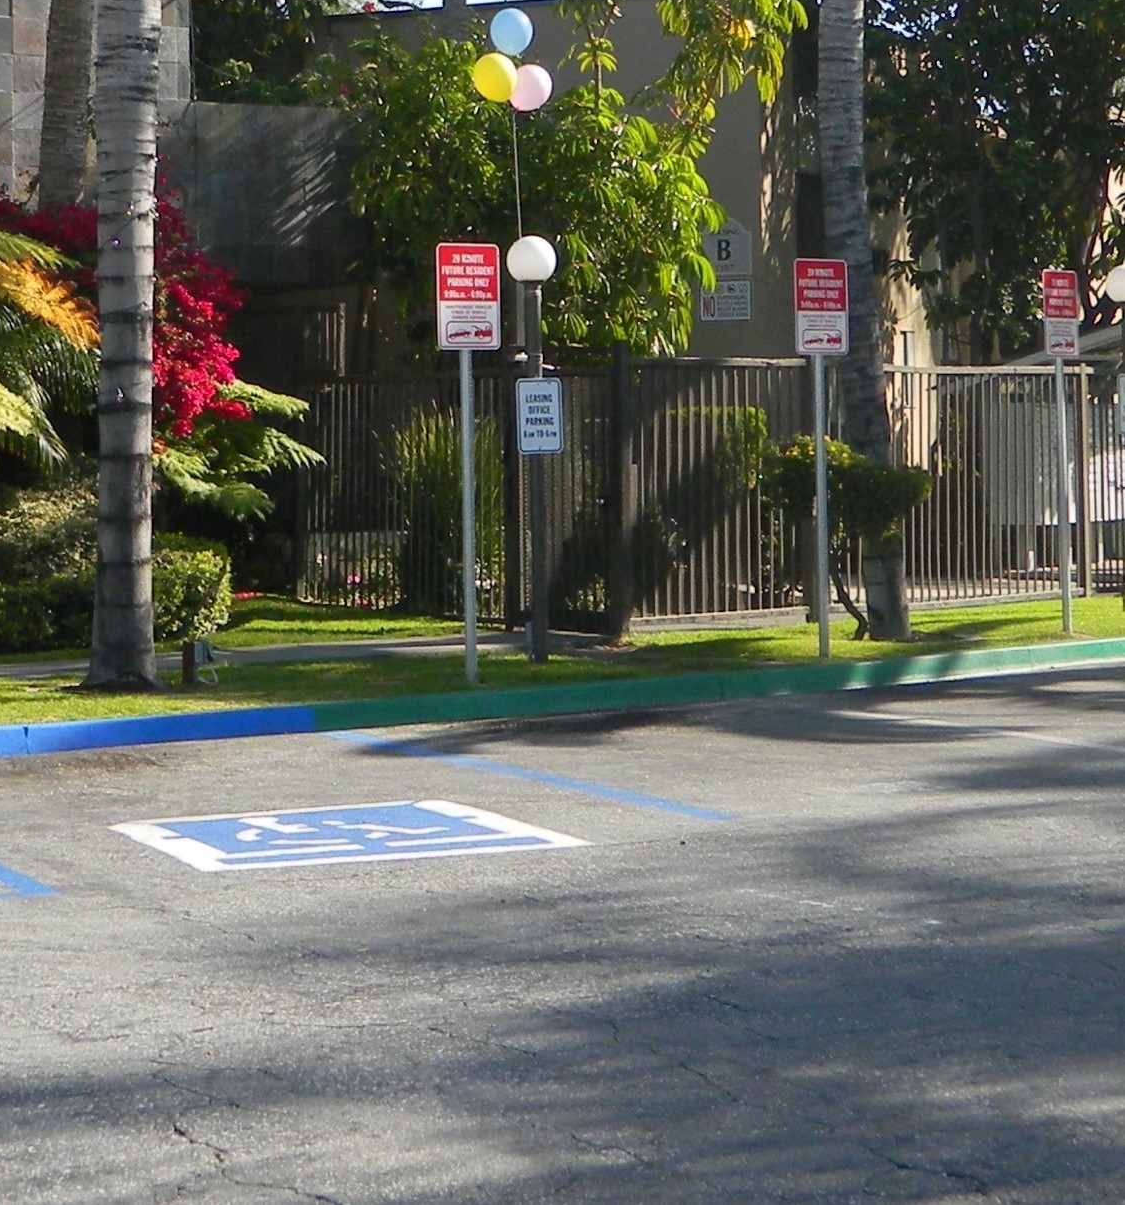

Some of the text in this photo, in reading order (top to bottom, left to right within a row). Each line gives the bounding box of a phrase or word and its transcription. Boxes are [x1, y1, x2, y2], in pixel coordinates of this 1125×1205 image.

[717, 239, 731, 261] B
[461, 254, 485, 264] MINUTE
[441, 266, 495, 275] FUTURE RESIDENT
[447, 278, 490, 287] PARKING ONLY
[803, 290, 826, 298] PARKING
[702, 296, 715, 318] NO
[525, 394, 553, 403] LEASING
[528, 406, 551, 414] OFFICE
[525, 417, 554, 426] PARKING
[536, 429, 544, 438] TO
